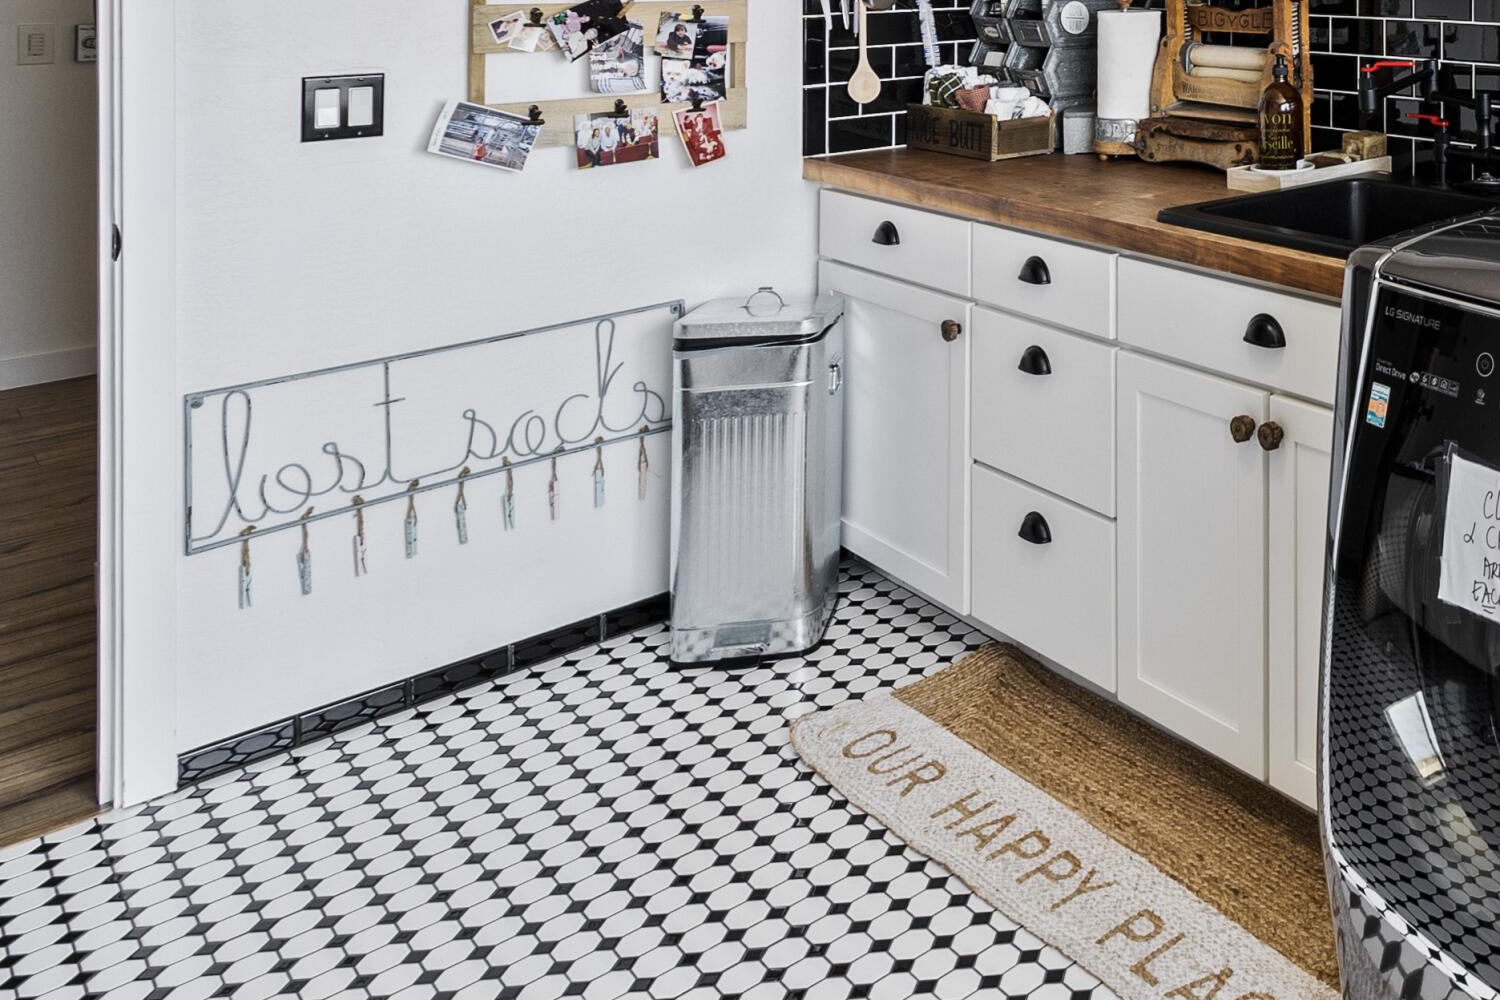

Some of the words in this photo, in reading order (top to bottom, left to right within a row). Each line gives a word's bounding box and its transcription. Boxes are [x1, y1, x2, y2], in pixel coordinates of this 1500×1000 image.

[1385, 306, 1395, 317] LG
[1396, 309, 1440, 330] SIGNATURE
[455, 318, 673, 460] socks
[190, 361, 412, 540] lost
[843, 729, 947, 797] OUR
[930, 790, 1117, 912] HAPPY
[1095, 908, 1277, 1000] PLA
